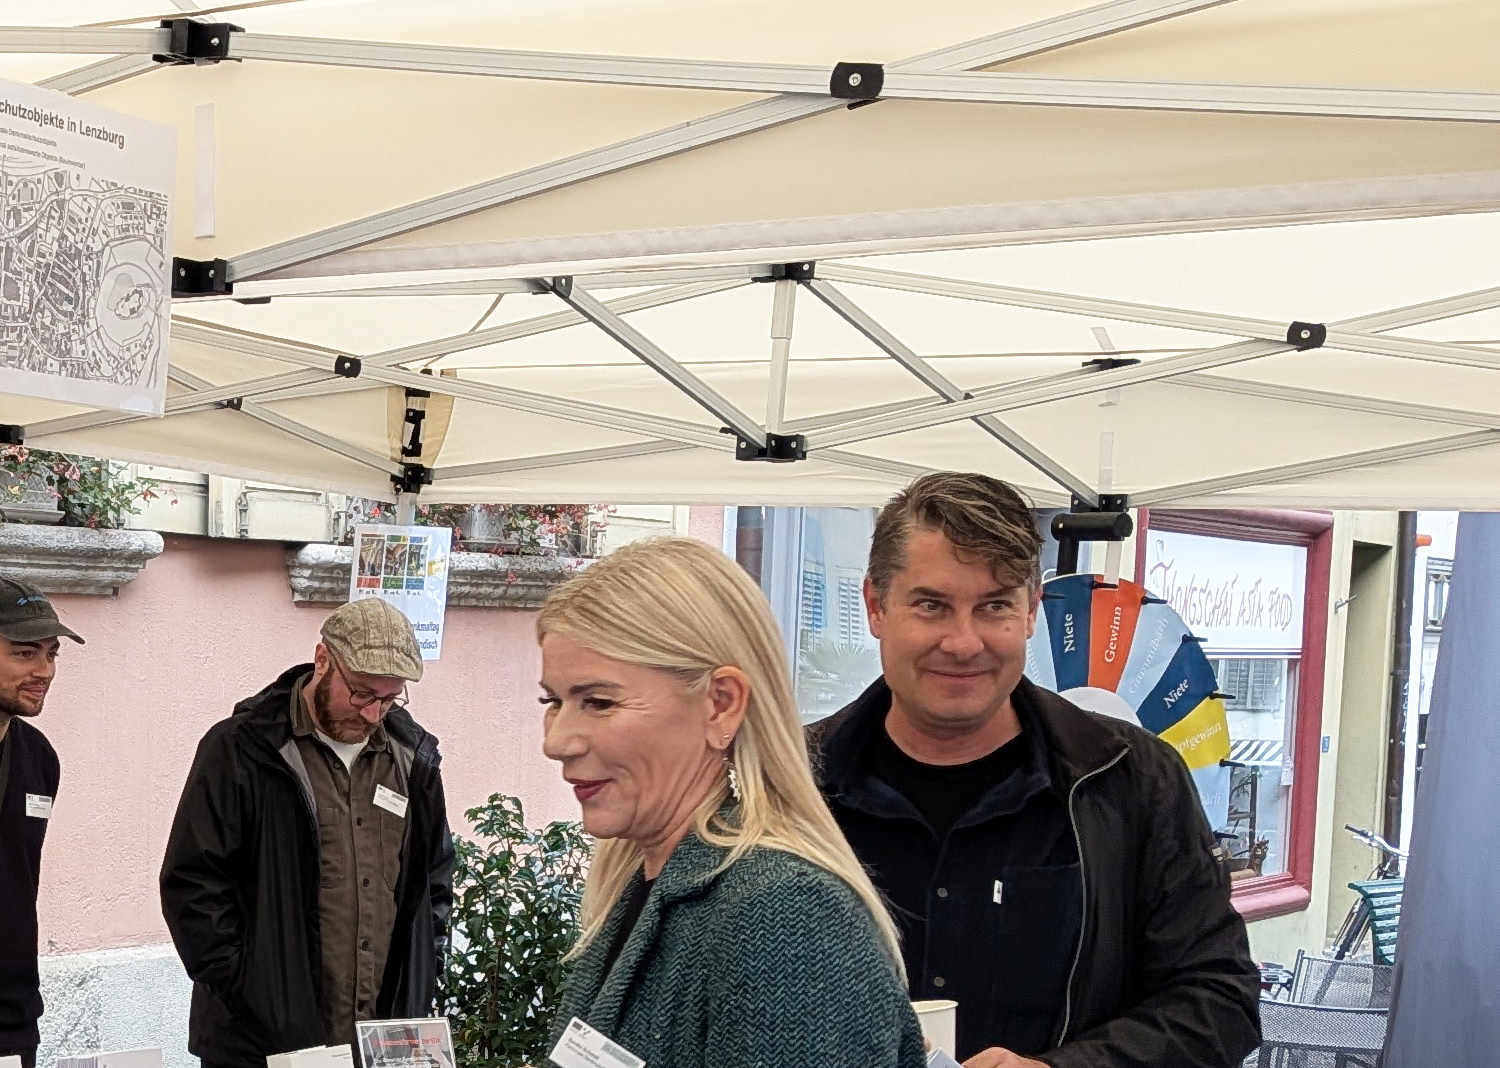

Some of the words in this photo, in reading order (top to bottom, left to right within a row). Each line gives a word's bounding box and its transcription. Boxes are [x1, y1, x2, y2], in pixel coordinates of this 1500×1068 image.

[67, 116, 77, 133] in
[79, 120, 125, 149] Lenzburg
[1063, 613, 1076, 653] Niete
[1104, 606, 1122, 663] Gewinn
[1162, 678, 1190, 710] Niete
